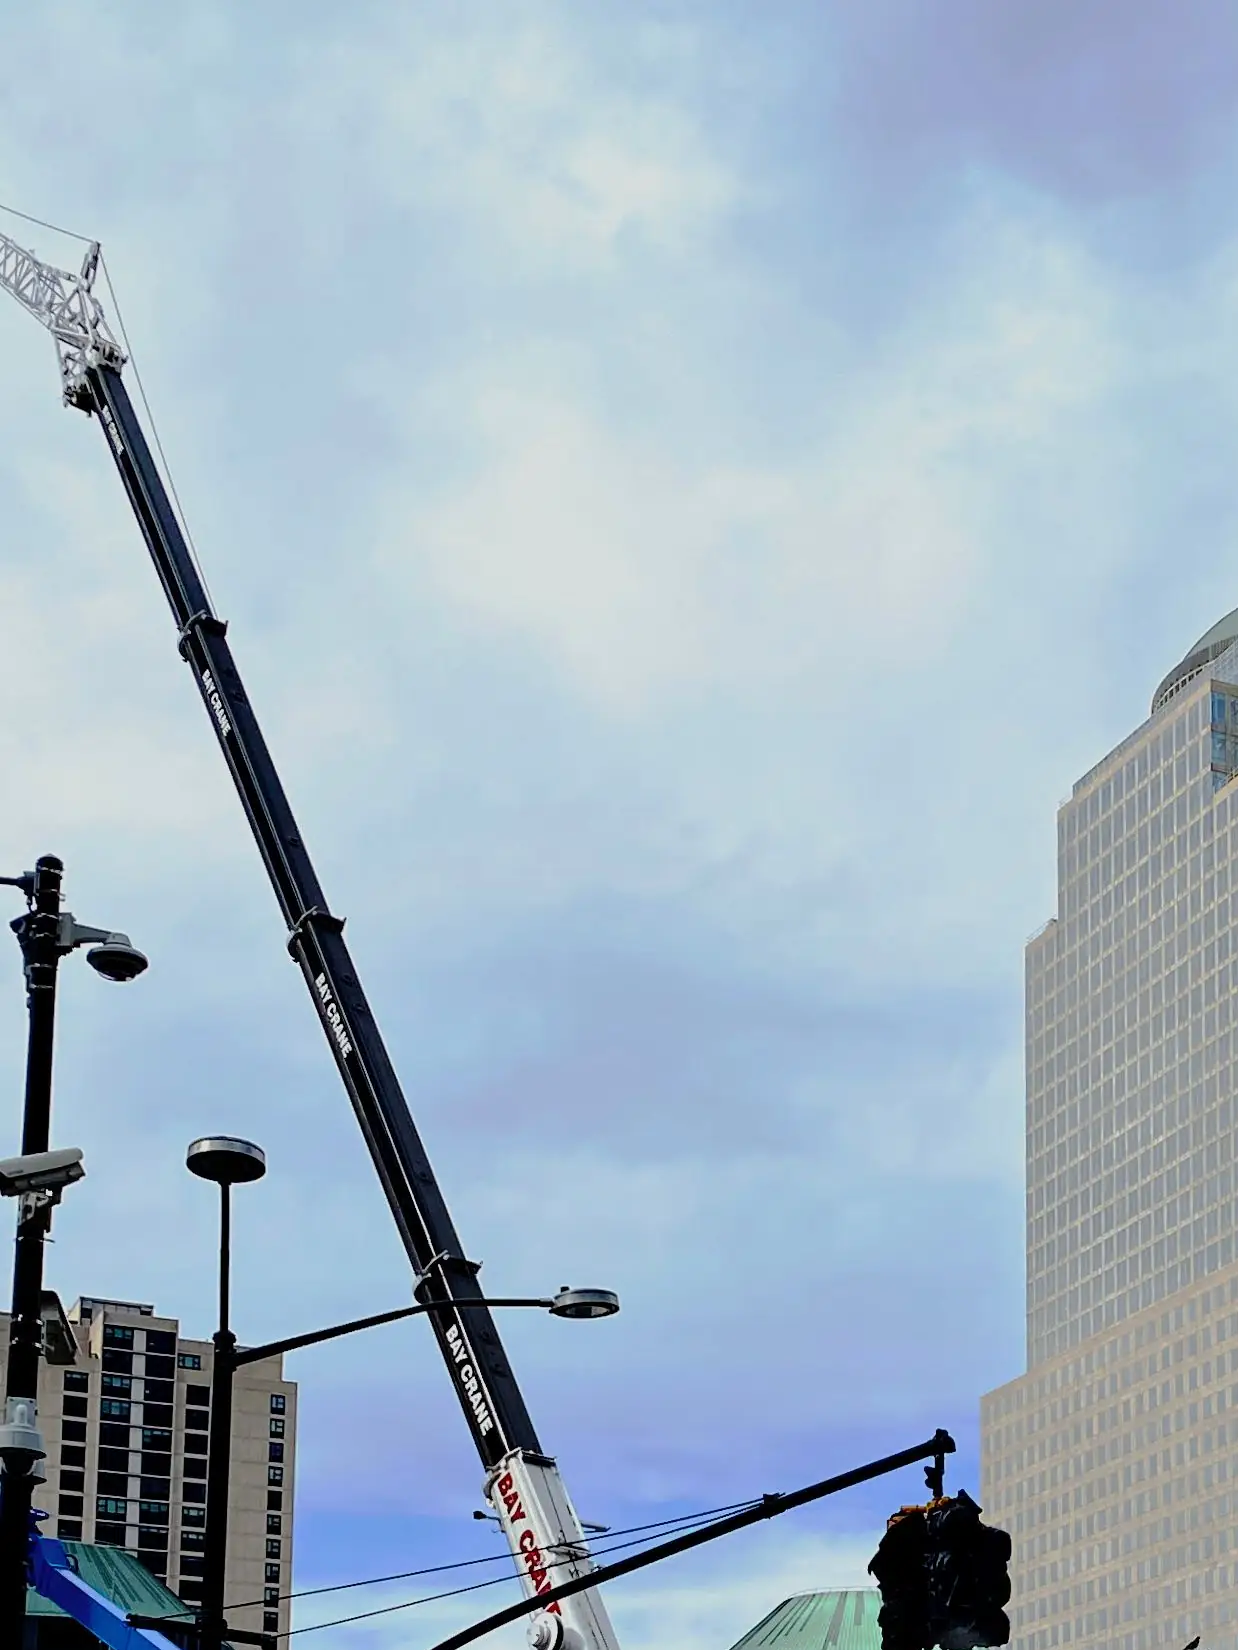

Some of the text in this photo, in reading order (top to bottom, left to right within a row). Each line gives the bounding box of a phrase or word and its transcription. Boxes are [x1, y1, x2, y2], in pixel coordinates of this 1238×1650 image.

[315, 972, 352, 1058] BAY CRANE
[446, 1324, 493, 1436] BAY CRANE
[498, 1472, 526, 1524] BAY
